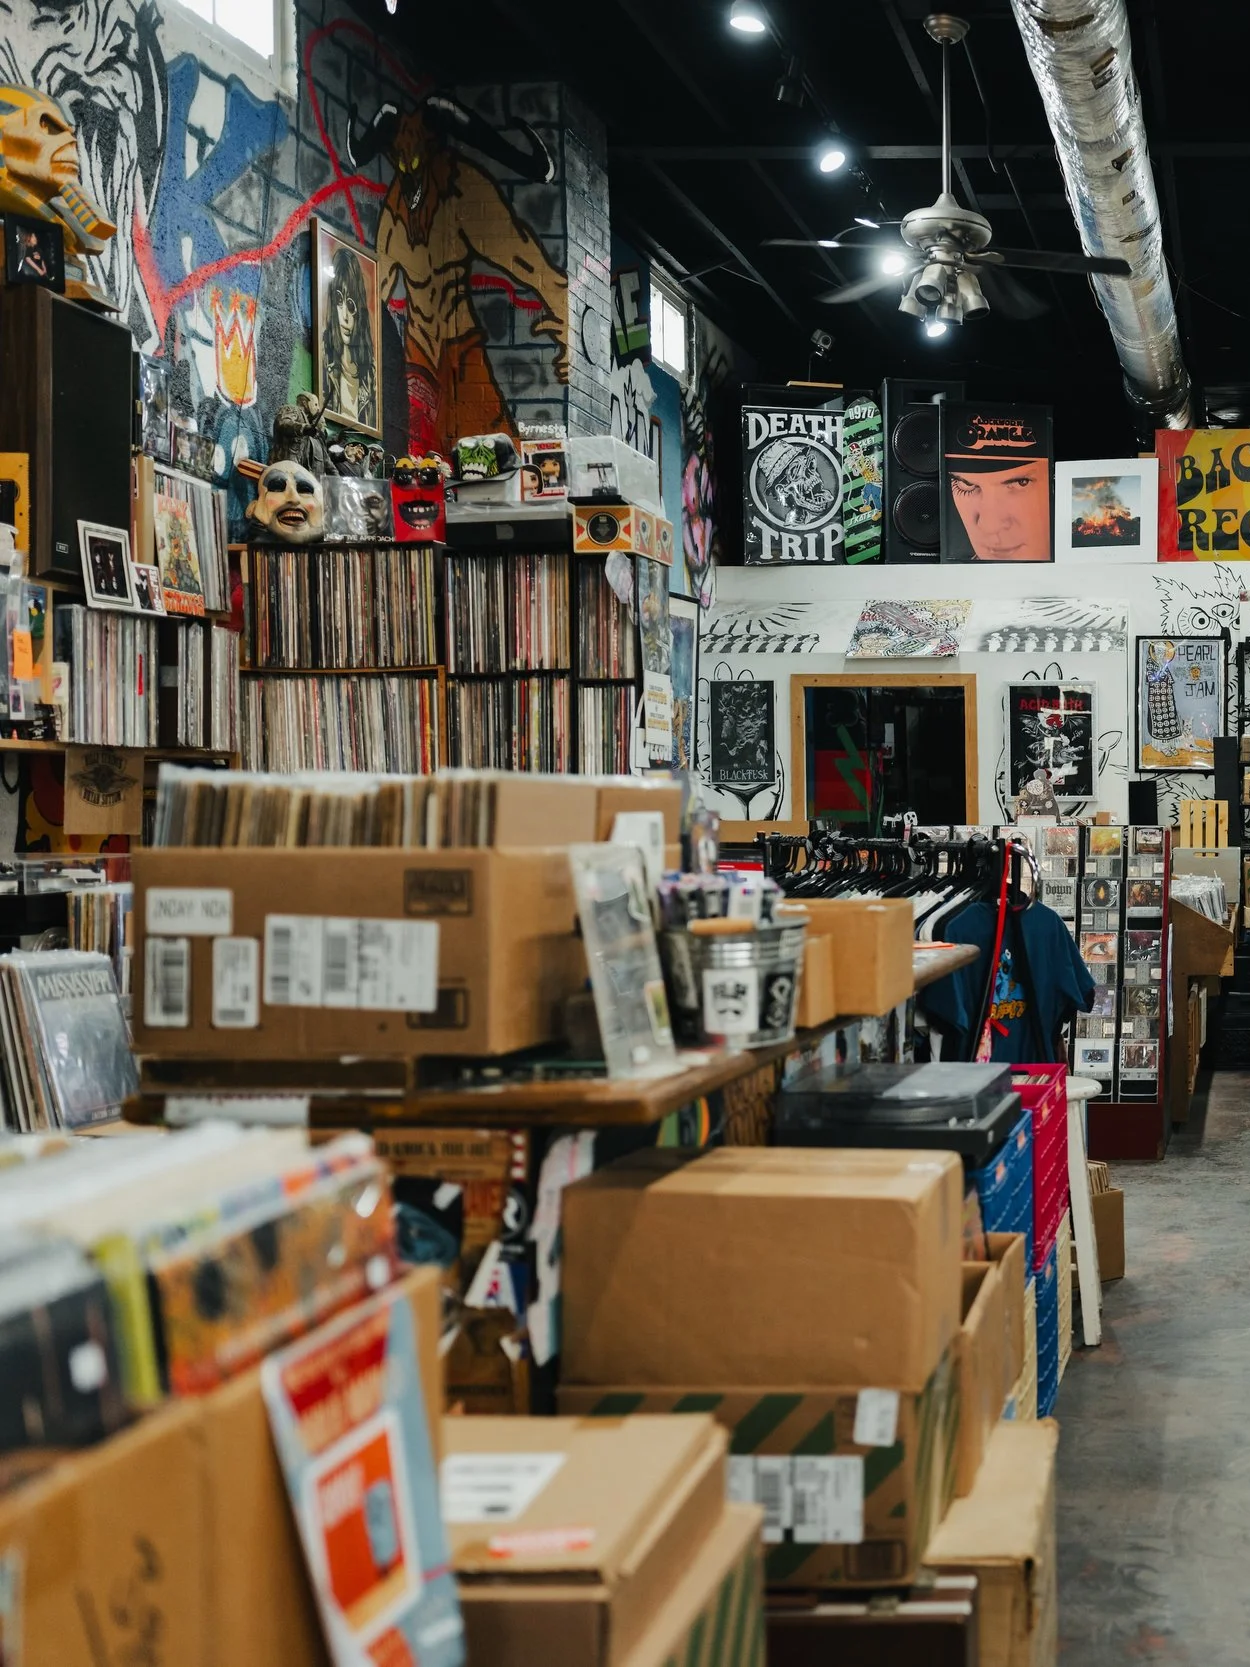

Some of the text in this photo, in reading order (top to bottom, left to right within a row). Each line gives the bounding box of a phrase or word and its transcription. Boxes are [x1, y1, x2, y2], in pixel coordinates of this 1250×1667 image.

[746, 412, 844, 453] DEATH
[957, 425, 1037, 449] ORANGE
[752, 516, 845, 561] TRIP
[1178, 645, 1216, 661] PEARL
[1186, 681, 1215, 697] JAM
[1045, 882, 1072, 895] down
